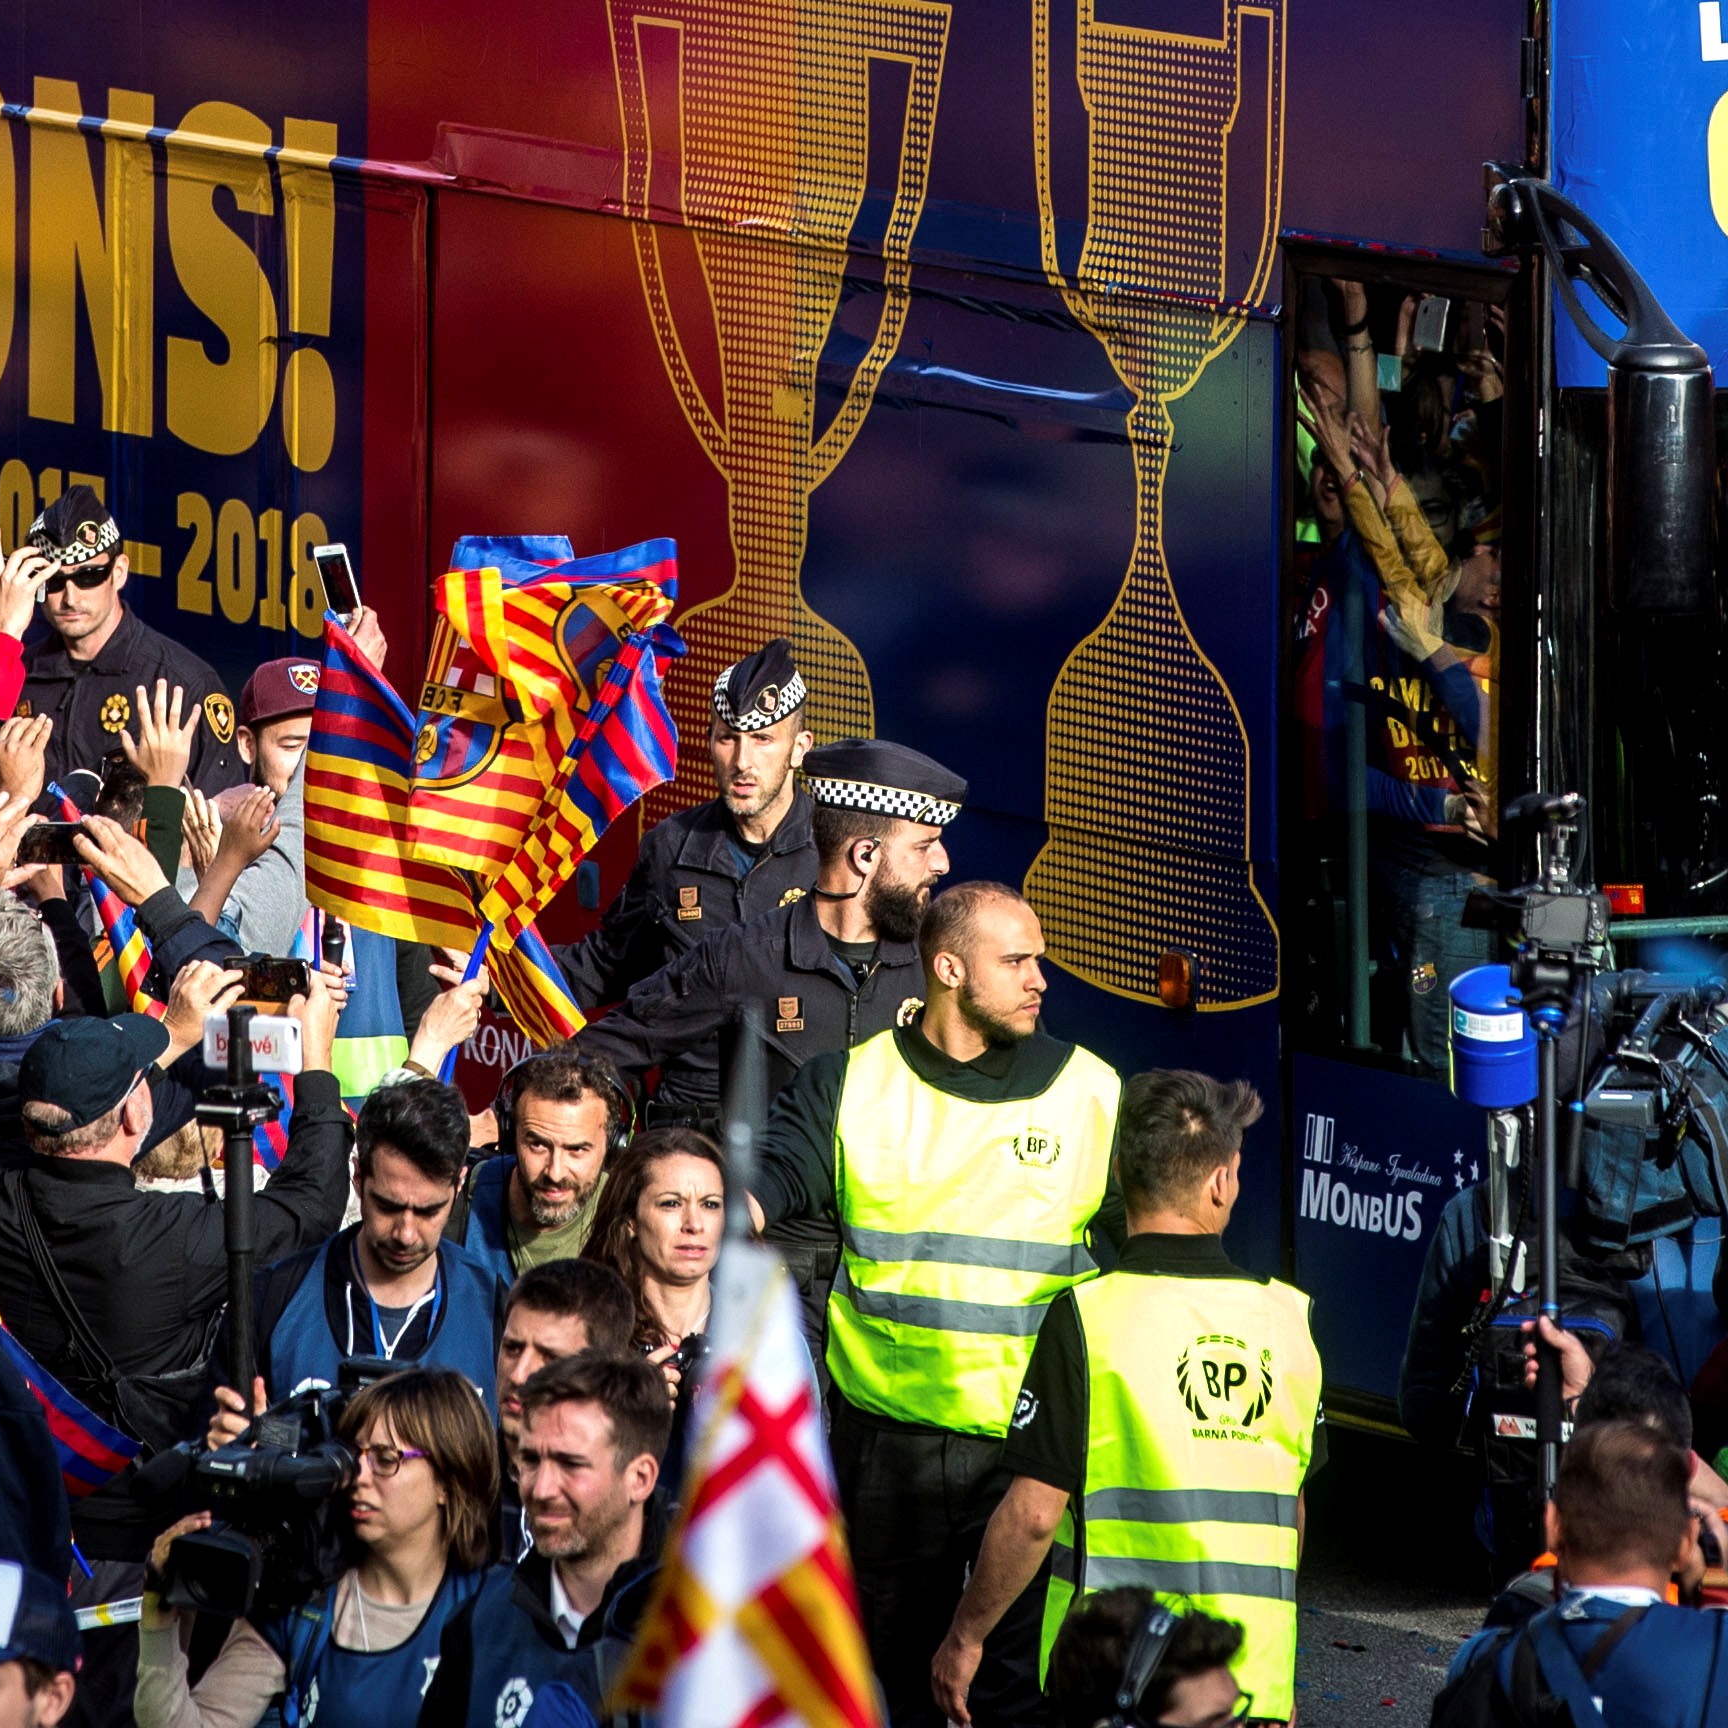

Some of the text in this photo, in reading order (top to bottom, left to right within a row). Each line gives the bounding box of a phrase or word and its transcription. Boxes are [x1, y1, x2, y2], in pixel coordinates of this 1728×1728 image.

[176, 491, 328, 640] 2018
[1201, 1359, 1248, 1402] BP
[1191, 1427, 1229, 1441] BARNA
